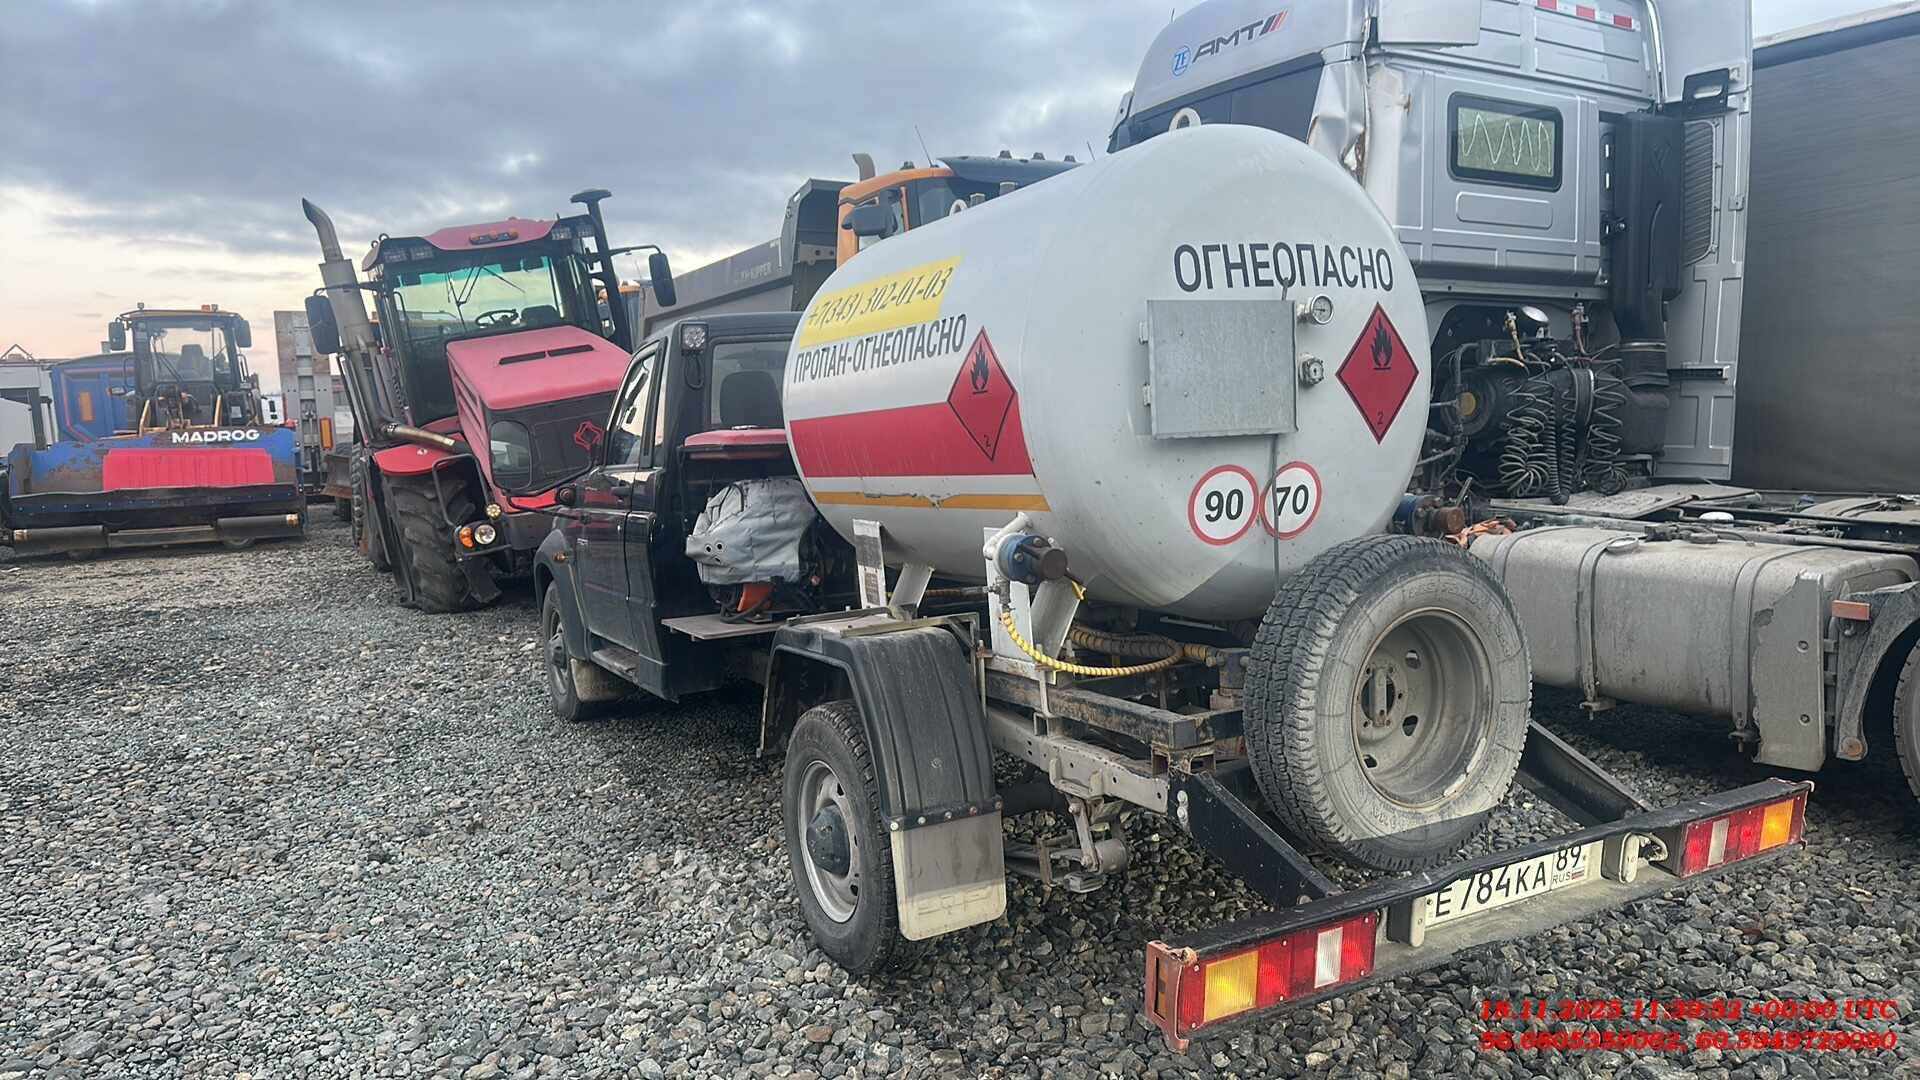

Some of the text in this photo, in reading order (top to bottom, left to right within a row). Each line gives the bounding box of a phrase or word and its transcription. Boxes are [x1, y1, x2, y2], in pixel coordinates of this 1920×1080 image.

[1191, 20, 1264, 63] AMT
[1174, 241, 1394, 293] ОГНЕОПАСНО
[808, 266, 954, 331] +7(343) 302-01-03
[792, 313, 968, 385] ПРОПАН-ОГНЕОПАСНО
[1377, 412, 1385, 425] 2
[171, 429, 260, 444] MADROG
[983, 433, 992, 448] 2
[1204, 488, 1245, 523] 90
[1275, 484, 1310, 518] 70
[1555, 845, 1582, 872] 89
[1553, 871, 1572, 884] RUS
